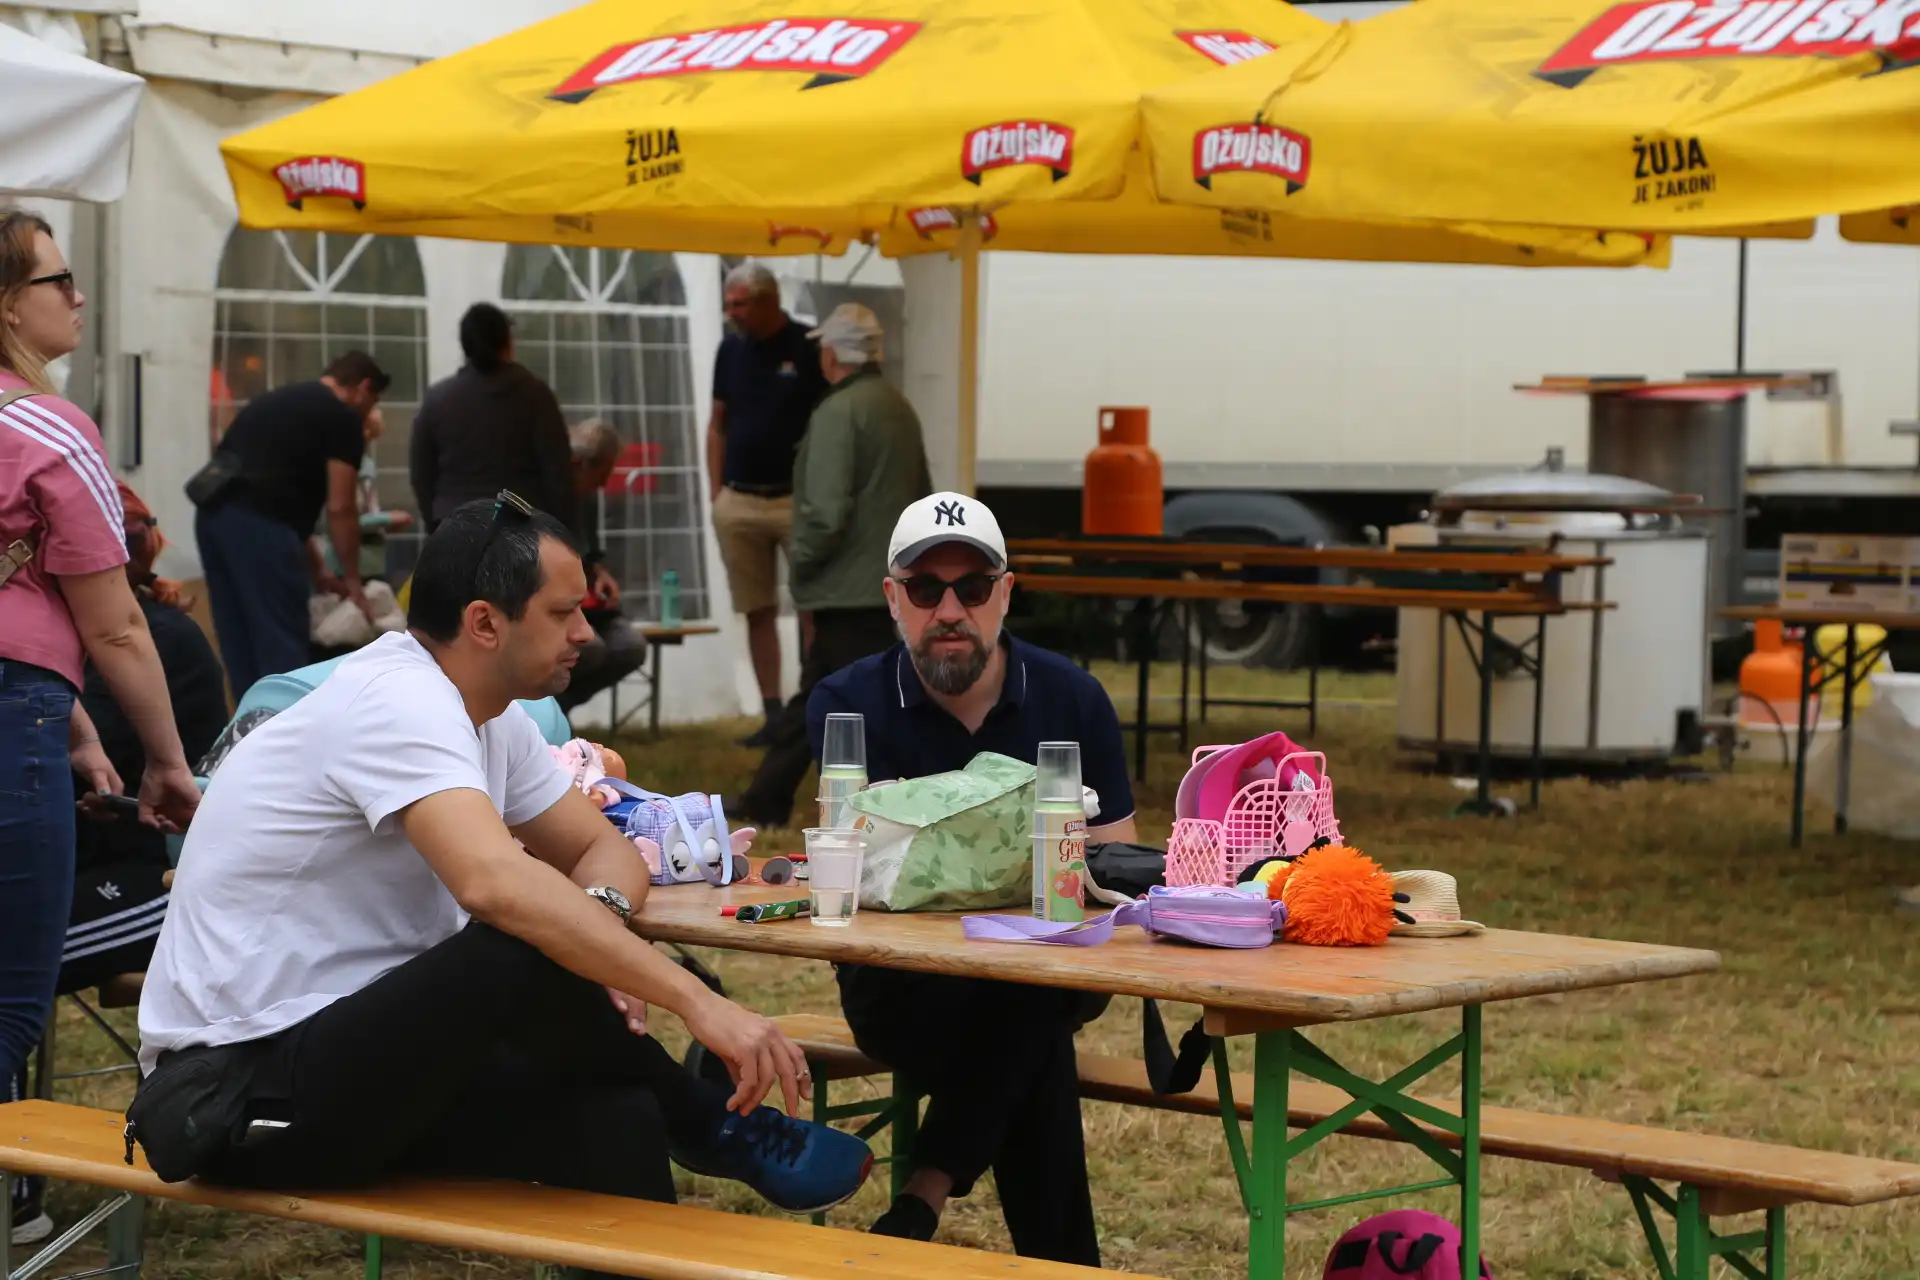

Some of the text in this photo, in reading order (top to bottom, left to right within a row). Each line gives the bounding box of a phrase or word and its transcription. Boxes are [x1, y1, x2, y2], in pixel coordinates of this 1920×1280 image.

[593, 19, 891, 84] Ožujsko
[1591, 0, 1920, 59] Ožujsk
[625, 128, 680, 167] ŽUJA
[1201, 126, 1303, 174] Ožujsko
[1631, 135, 1709, 179] ŽUJA
[1632, 173, 1716, 204] JE ZAKON!
[934, 500, 966, 526] NY
